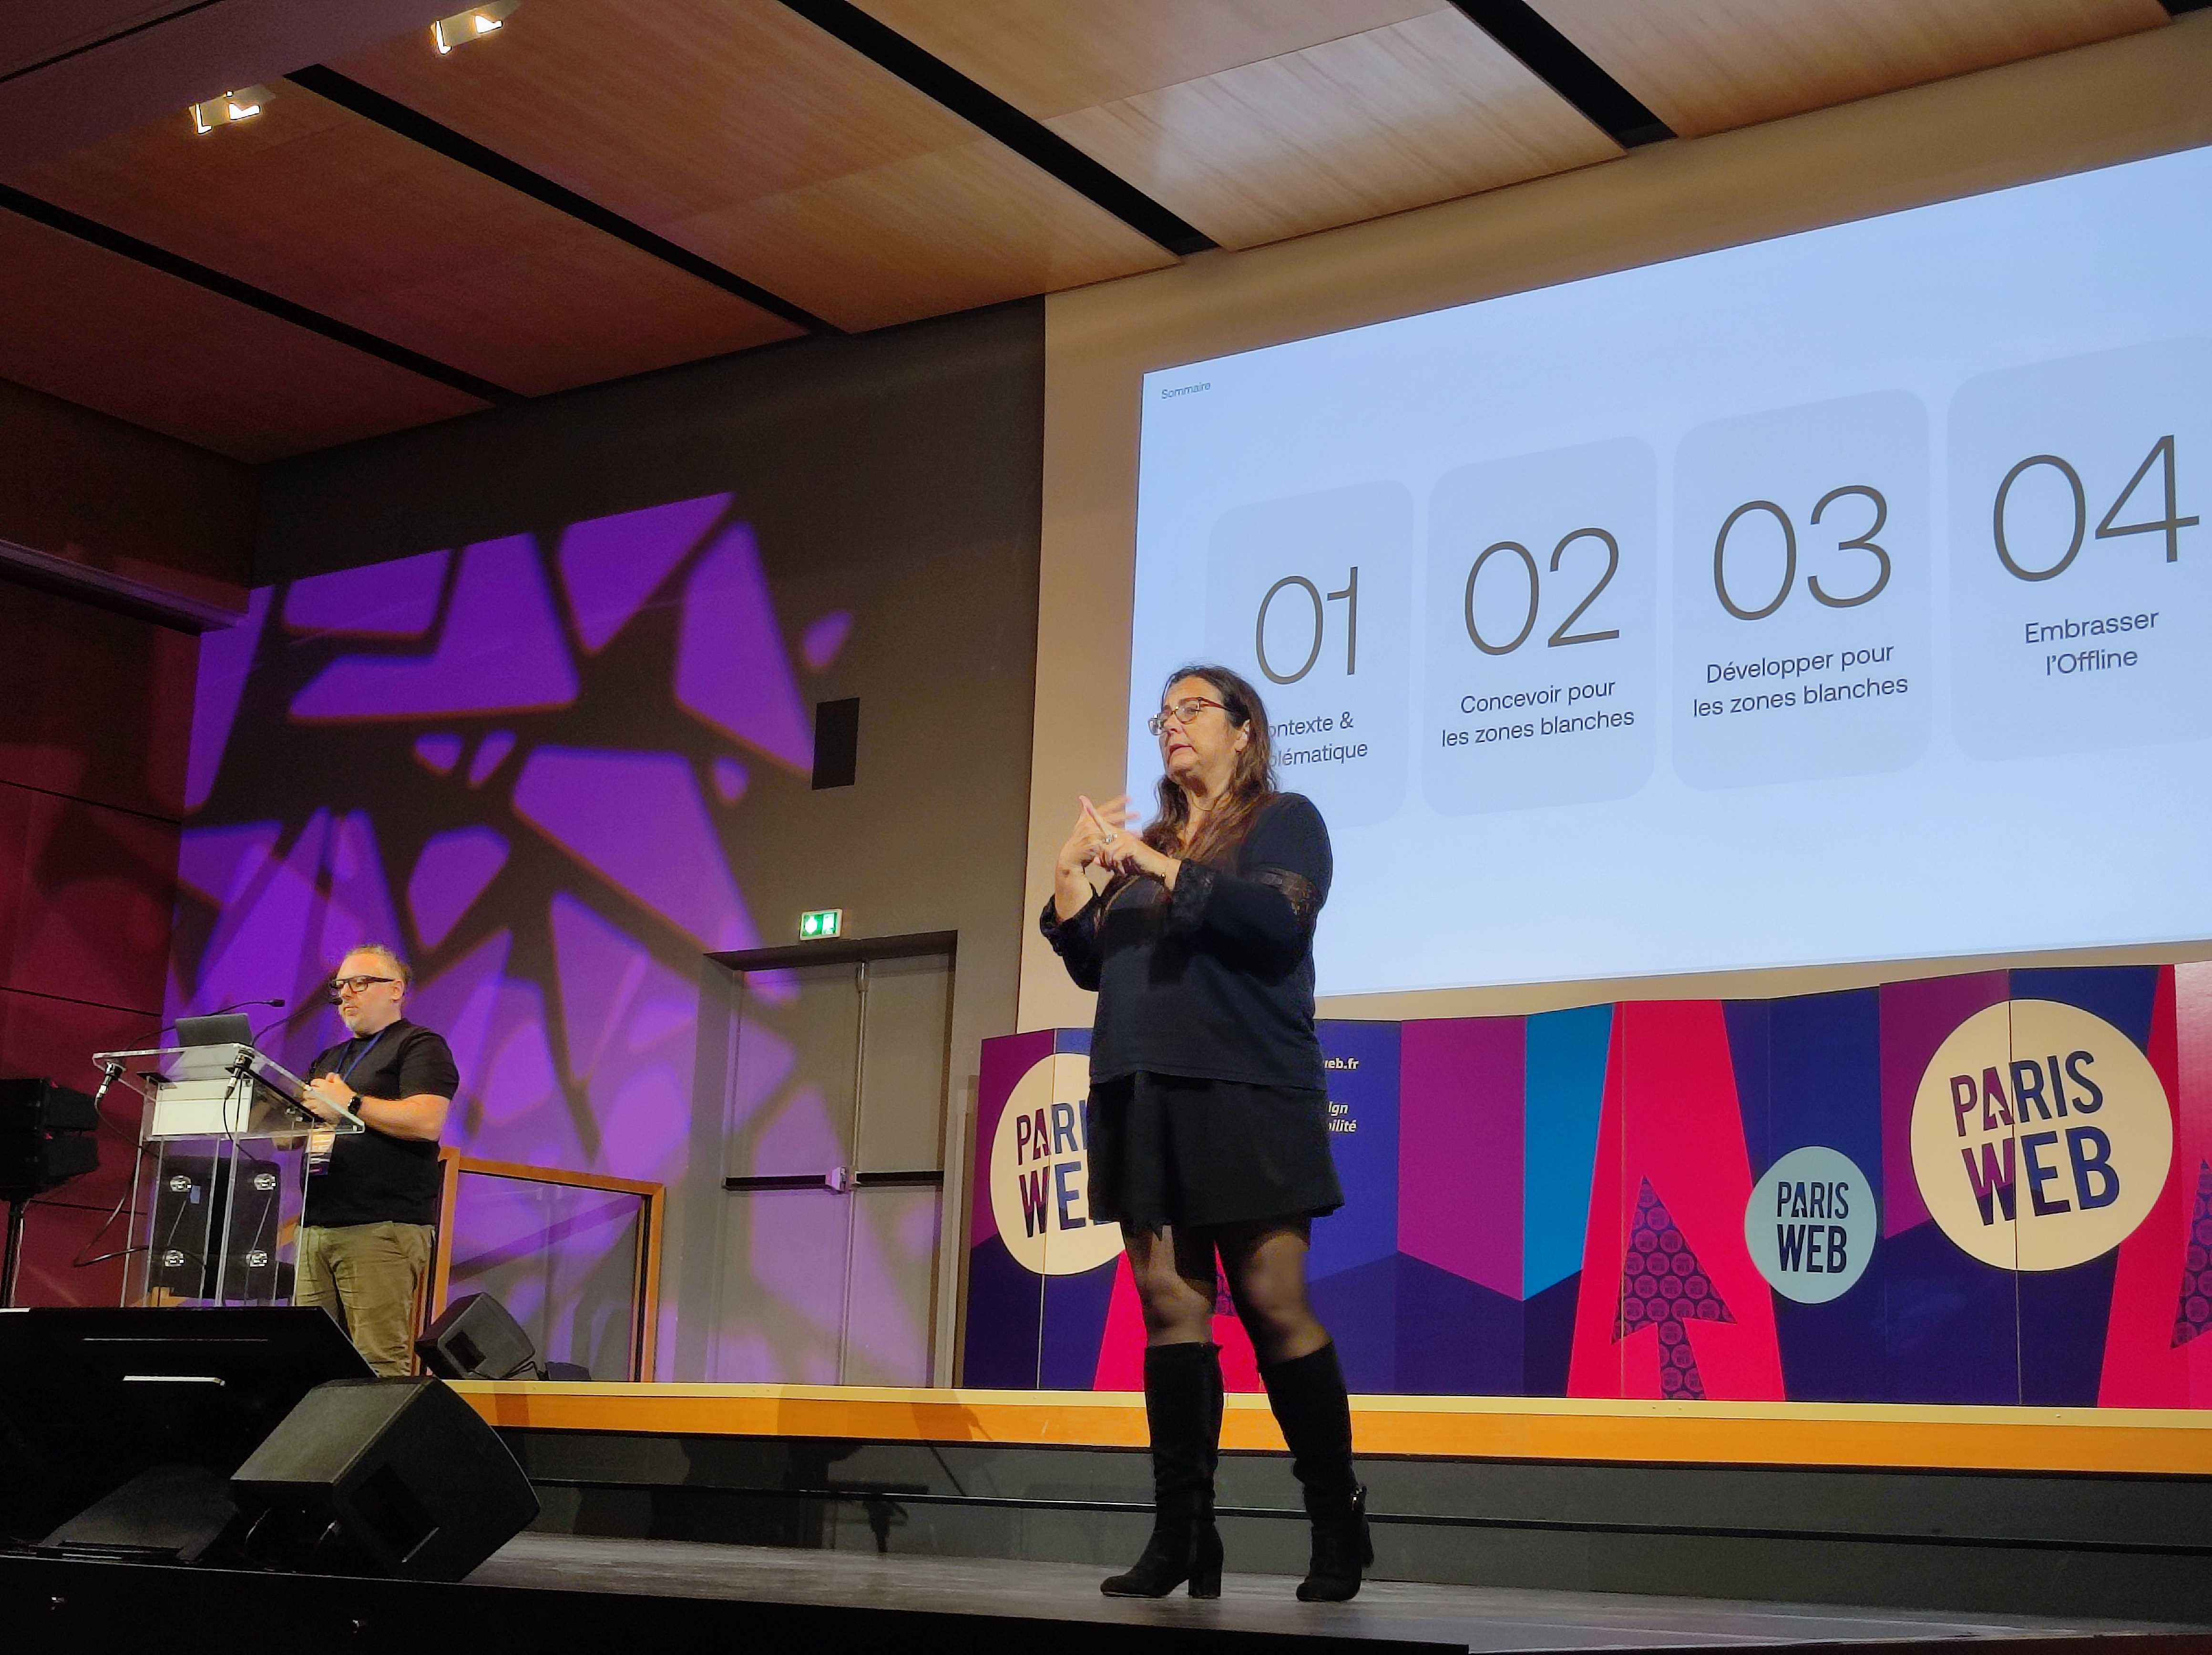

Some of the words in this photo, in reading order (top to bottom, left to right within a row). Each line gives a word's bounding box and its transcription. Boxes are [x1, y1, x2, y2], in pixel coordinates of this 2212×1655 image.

[1161, 382, 1211, 399] Sommaire
[1993, 435, 2200, 582] 04
[1714, 485, 1891, 621] 03
[1464, 528, 1619, 655] 02
[1256, 566, 1358, 685] 01
[2025, 612, 2160, 644] Embrasser
[1706, 654, 1834, 684] Développer
[1841, 645, 1895, 672] pour
[2046, 648, 2138, 675] l’Offline
[1460, 684, 1562, 714] Concevoir
[1568, 681, 1616, 705] pour
[1693, 699, 1723, 717] les
[1730, 690, 1796, 714] zones
[1803, 677, 1908, 705] blanches
[1268, 716, 1333, 738] ontexte
[1340, 711, 1354, 729] &
[1442, 729, 1469, 747] les
[1475, 723, 1534, 744] zones
[1540, 710, 1635, 736] blanches
[1324, 1057, 1359, 1070] eb.fr
[1328, 1101, 1349, 1116] ign
[1949, 1050, 2104, 1137] PARIS
[1016, 1099, 1088, 1165] PARI
[1328, 1119, 1357, 1133] ilité
[1960, 1125, 2120, 1226] WEB
[1018, 1161, 1116, 1238] WE
[1777, 1181, 1849, 1219] PARIS
[1777, 1224, 1847, 1273] WEB
